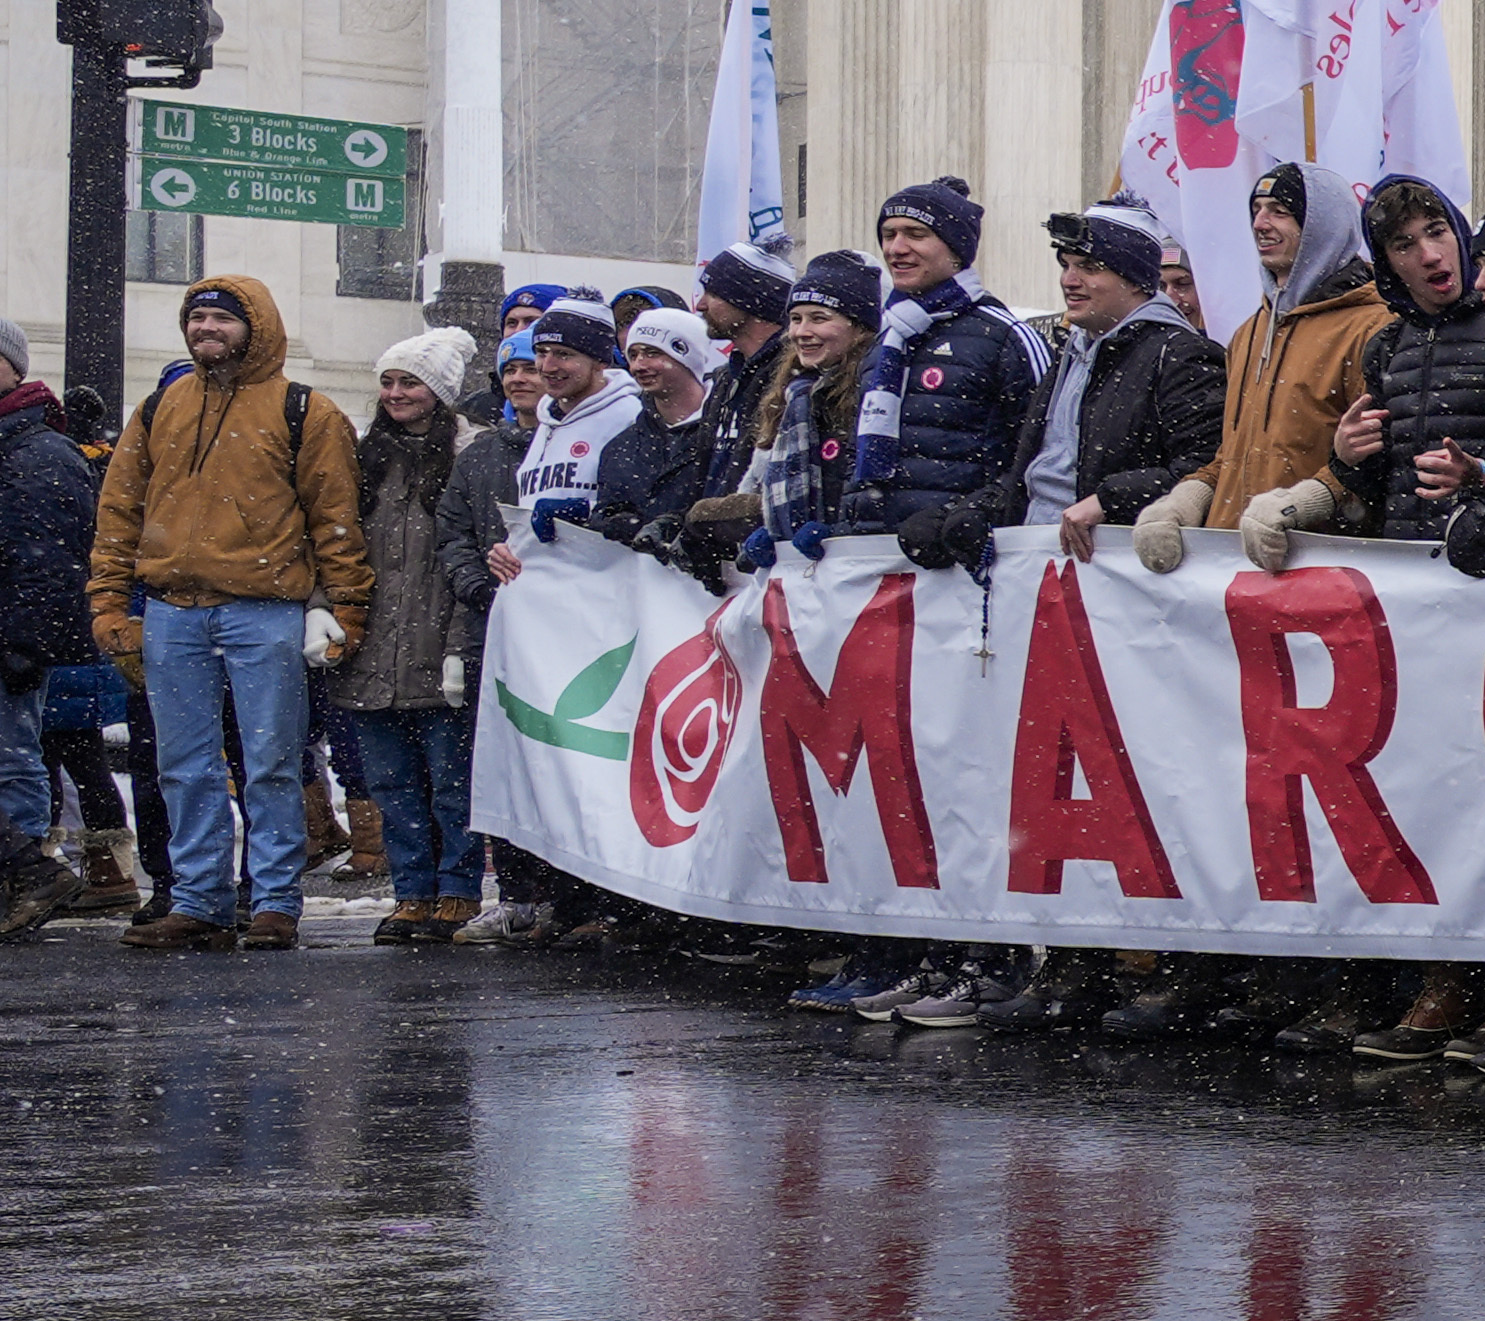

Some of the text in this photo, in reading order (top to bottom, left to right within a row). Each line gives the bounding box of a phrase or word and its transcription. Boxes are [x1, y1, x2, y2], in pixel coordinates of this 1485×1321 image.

[211, 111, 338, 134] Capitol South Station
[161, 142, 191, 151] metro
[229, 125, 318, 153] 3 Blocks
[222, 147, 246, 158] Blue
[265, 151, 301, 164] Orange
[306, 155, 329, 166] Line
[224, 168, 321, 184] UNION STATION
[228, 181, 318, 206] 6 Blocks
[247, 204, 298, 216] Red Line
[350, 213, 379, 222] metro
[519, 470, 537, 498] WE
